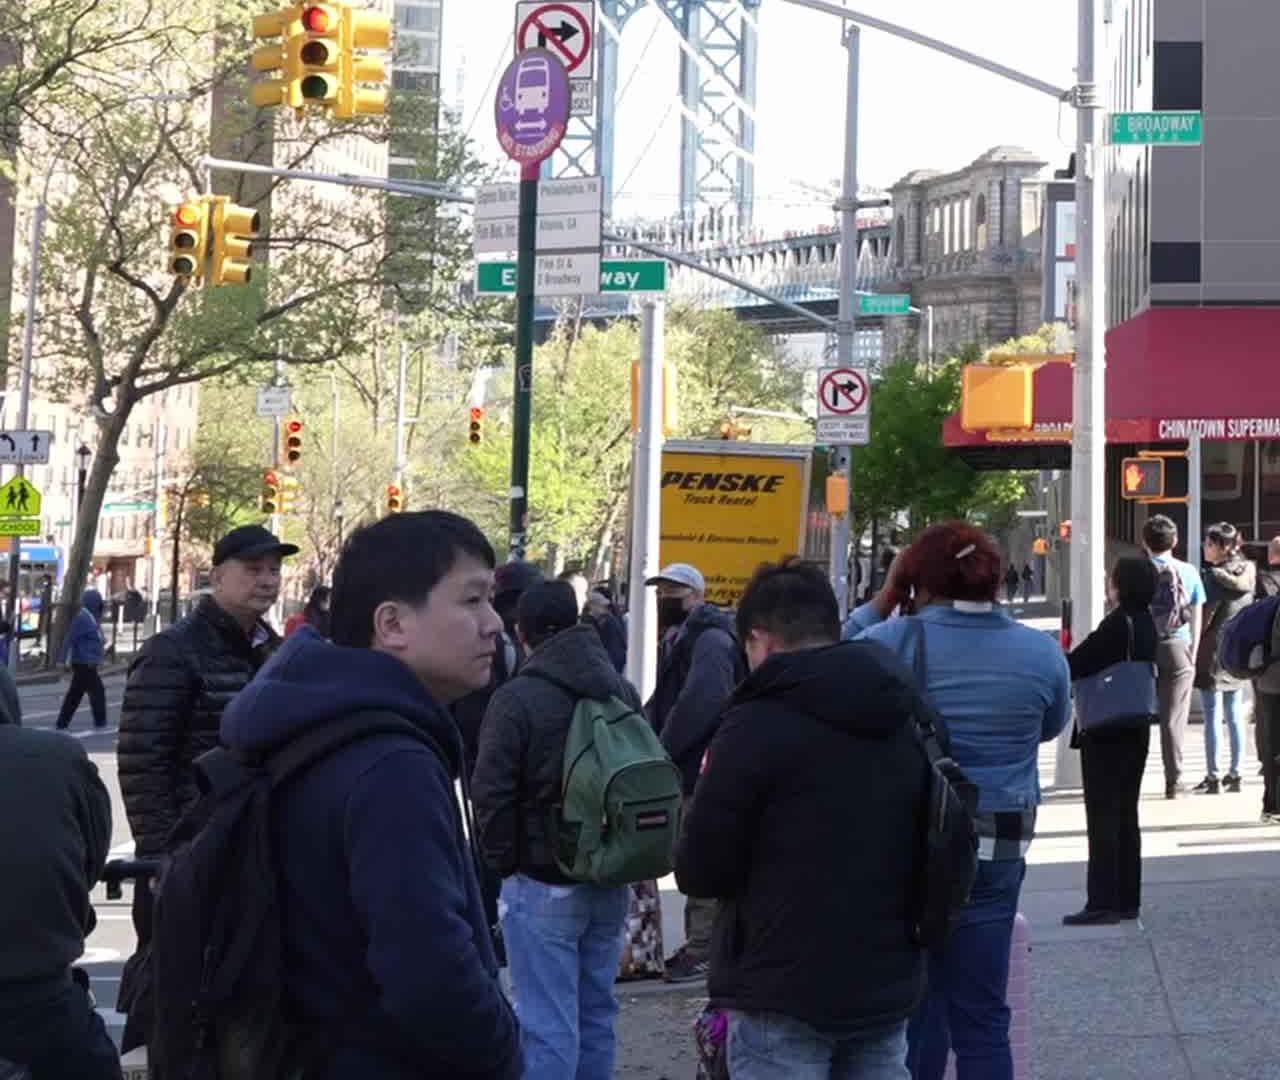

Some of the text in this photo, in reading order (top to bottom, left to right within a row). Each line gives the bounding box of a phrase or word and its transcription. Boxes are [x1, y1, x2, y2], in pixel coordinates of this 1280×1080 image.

[1127, 115, 1195, 133] BROADWAY
[1159, 419, 1225, 439] CHINATOWN
[661, 471, 785, 494] PENSKE
[684, 493, 716, 505] Truck
